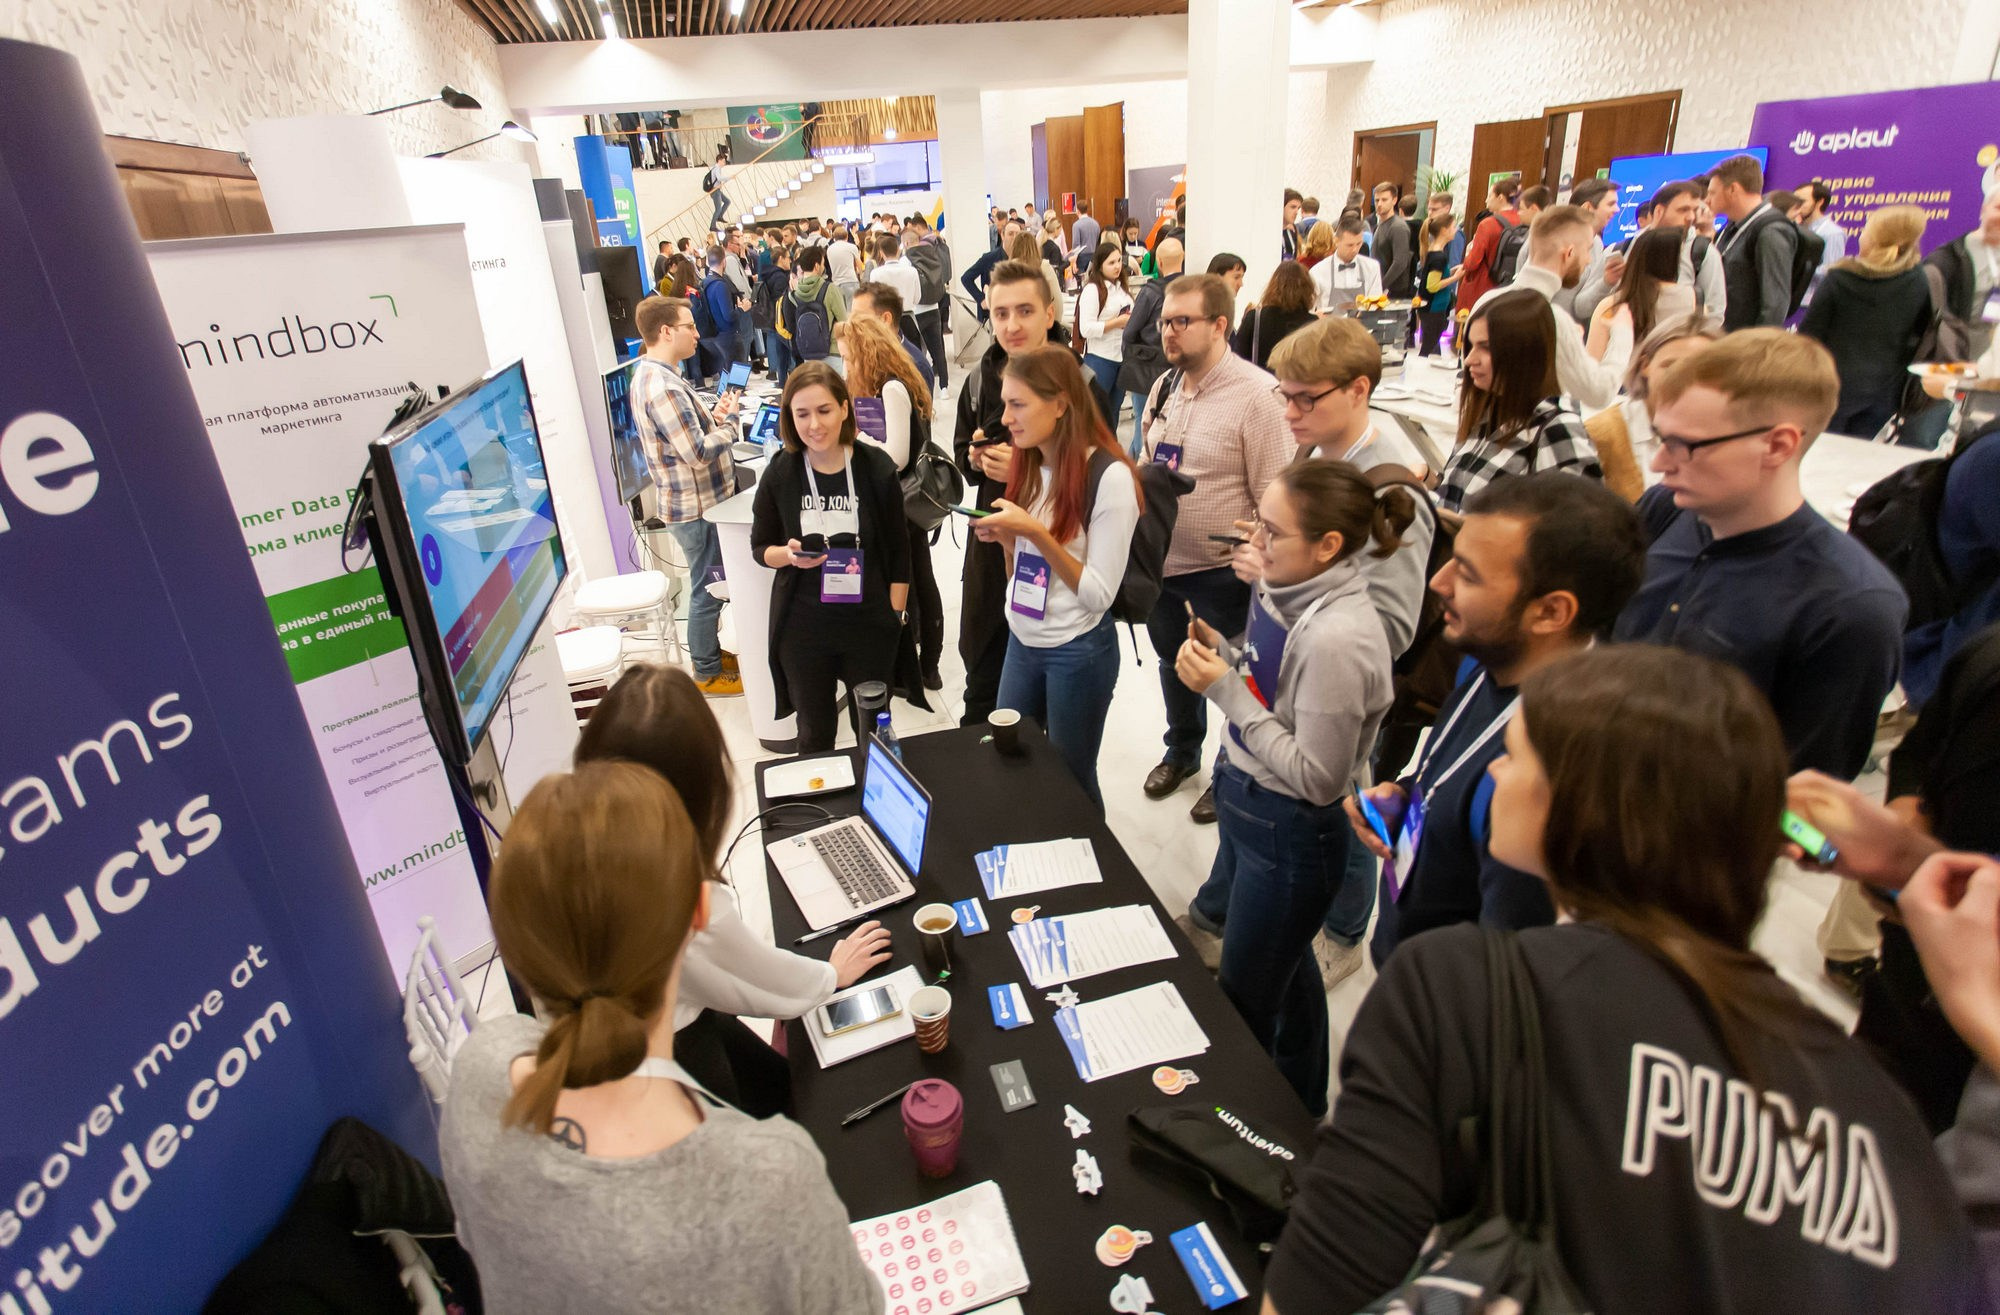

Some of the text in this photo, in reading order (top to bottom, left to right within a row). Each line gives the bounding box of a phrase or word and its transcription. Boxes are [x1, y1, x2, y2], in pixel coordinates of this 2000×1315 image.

[1818, 123, 1899, 154] aplaut
[1844, 190, 1951, 208] управления
[471, 258, 506, 271] етинга
[178, 315, 384, 369] mindbox
[205, 382, 413, 427] ая платформа автоматизации
[260, 412, 342, 436] маркетинга
[0, 410, 100, 534] e
[242, 508, 285, 529] mer
[291, 495, 341, 517] Data
[247, 523, 345, 558] ома клие
[333, 593, 386, 617] покупа
[316, 614, 374, 641] единый
[322, 692, 420, 733] Программа лояльно
[0, 692, 194, 864] ams
[0, 795, 222, 1022] ducts
[0, 944, 268, 1248] scover more at
[1622, 1042, 1898, 1268] PUMA
